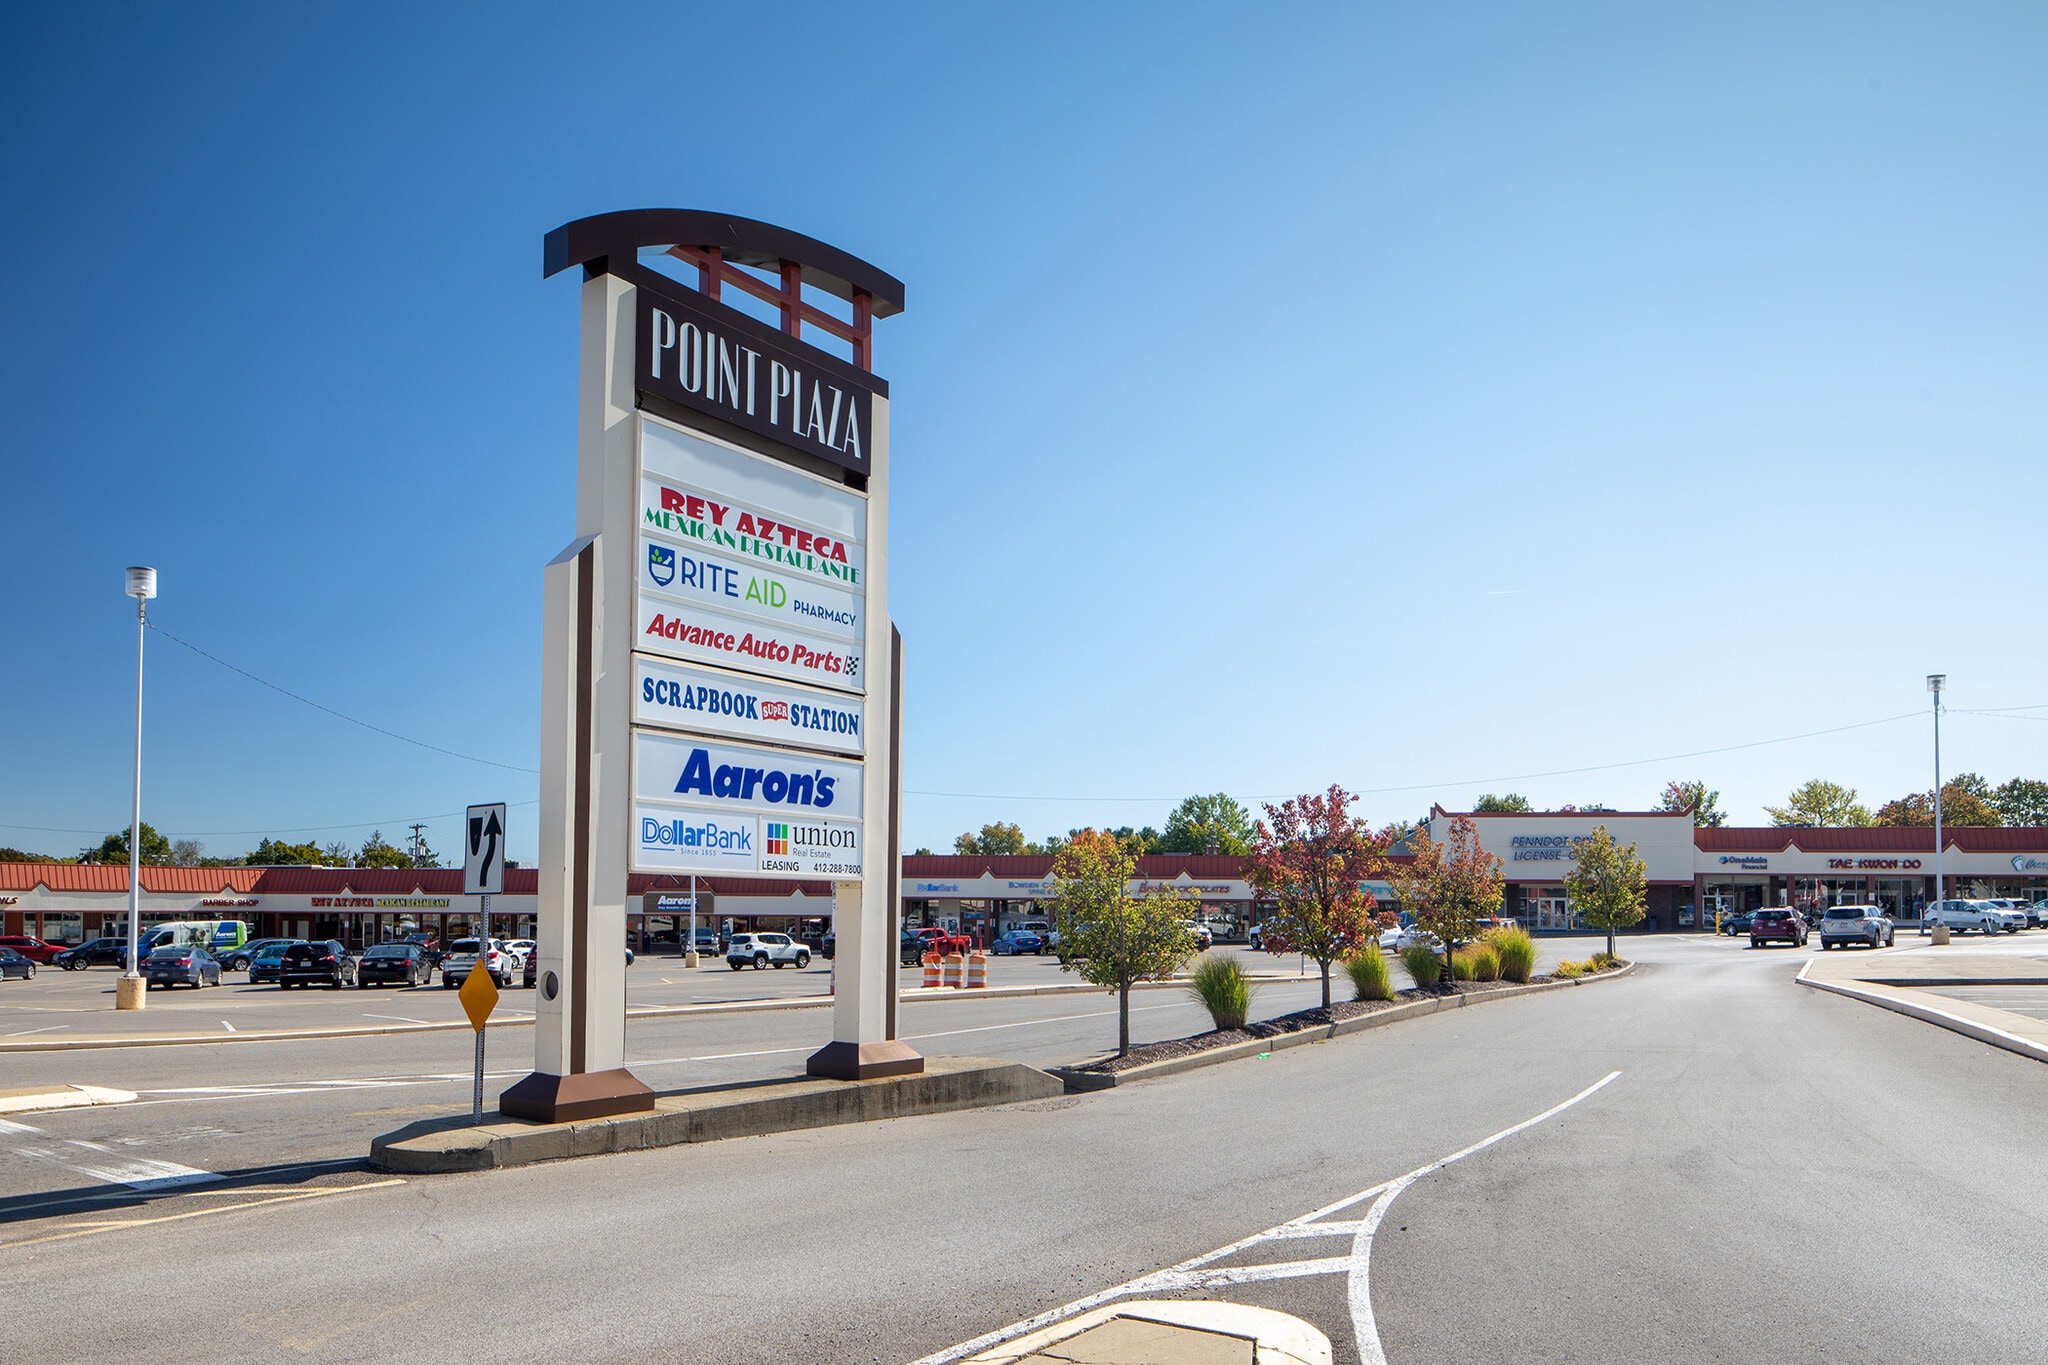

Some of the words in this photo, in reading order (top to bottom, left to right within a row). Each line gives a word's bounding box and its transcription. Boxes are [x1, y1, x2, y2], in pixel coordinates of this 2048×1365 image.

[652, 307, 761, 416] POINT
[770, 360, 861, 459] PLAZA
[660, 487, 729, 526] REY
[736, 512, 847, 563] AZTECA
[644, 507, 736, 549] MEXICAN
[740, 535, 860, 584] RESTAURANTE
[681, 557, 739, 598] RITE
[745, 576, 787, 608] AID
[794, 600, 856, 627] PHARMACY
[646, 613, 735, 651] Advance
[737, 633, 789, 662] Auto
[791, 644, 842, 674] Parts
[643, 677, 758, 720] SCRAPBOOK
[763, 703, 787, 718] SUPER
[791, 703, 859, 736] STATION
[674, 748, 836, 808] Aaron's
[793, 821, 856, 848] union
[762, 860, 800, 872] LEASING
[813, 862, 861, 874] 412-288-7800
[793, 848, 808, 857] Real
[810, 849, 832, 859] Estate
[1514, 850, 1562, 861] LICENSE
[1828, 859, 1853, 869] TAE
[1858, 859, 1898, 869] KWON
[1903, 859, 1922, 869] DO
[202, 899, 235, 907] BARBER
[238, 899, 259, 907] SHOP
[311, 897, 332, 907] REY
[334, 897, 374, 907] AZTECA
[376, 898, 406, 908] MEXICAN
[657, 895, 698, 905] Aaron
